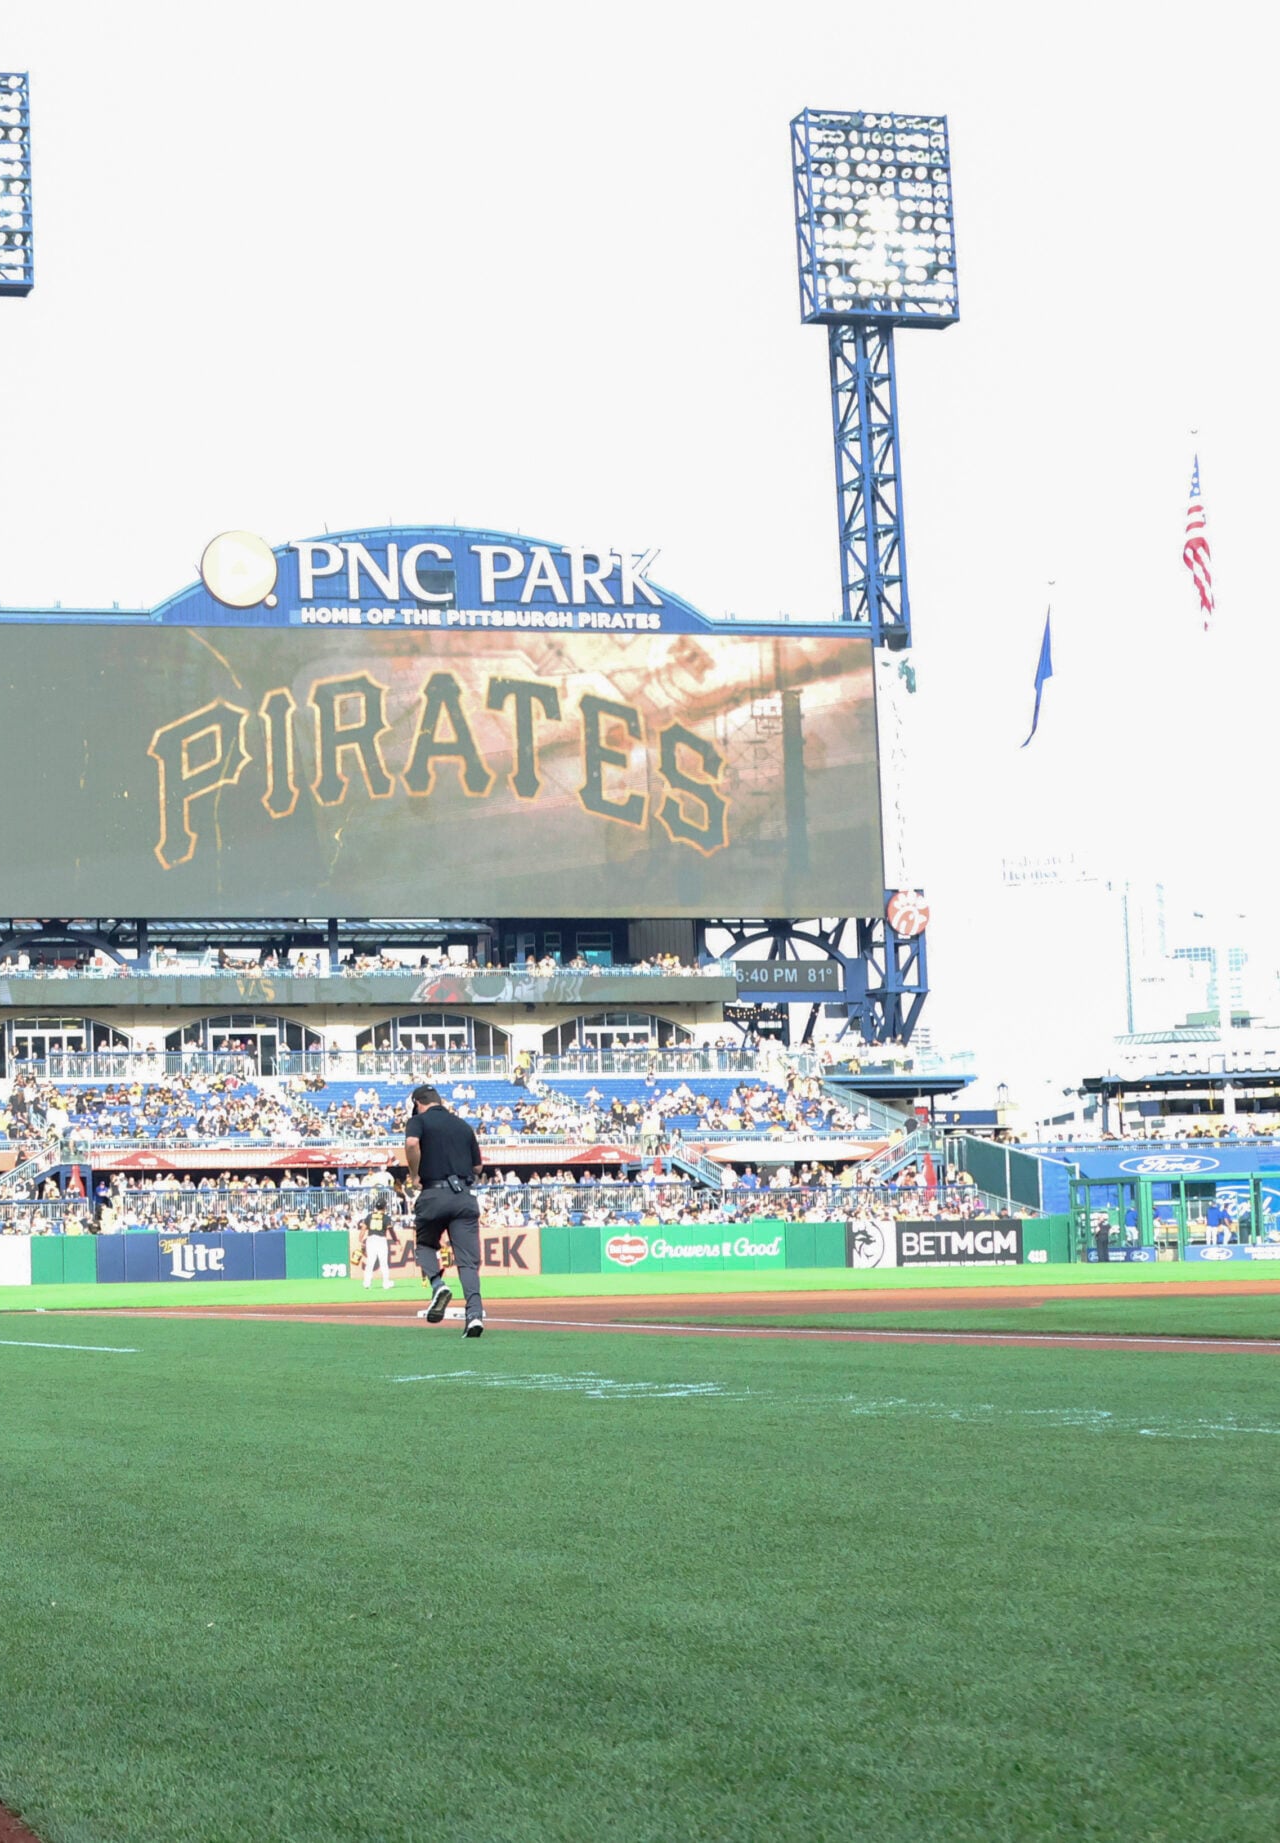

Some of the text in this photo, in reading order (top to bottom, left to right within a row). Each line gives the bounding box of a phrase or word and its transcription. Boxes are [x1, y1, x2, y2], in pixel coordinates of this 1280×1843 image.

[289, 541, 663, 607] PNC PARK
[301, 607, 661, 630] HOME OF THE PITTSBURGH PIRATES
[148, 669, 729, 870] PIRATES
[736, 967, 769, 983] 6:40
[773, 967, 798, 983] PM
[1136, 1156, 1203, 1173] Ford
[650, 1238, 720, 1259] Growers
[733, 1236, 782, 1257] Good
[901, 1229, 1017, 1256] BETMGM
[169, 1243, 225, 1279] Lite
